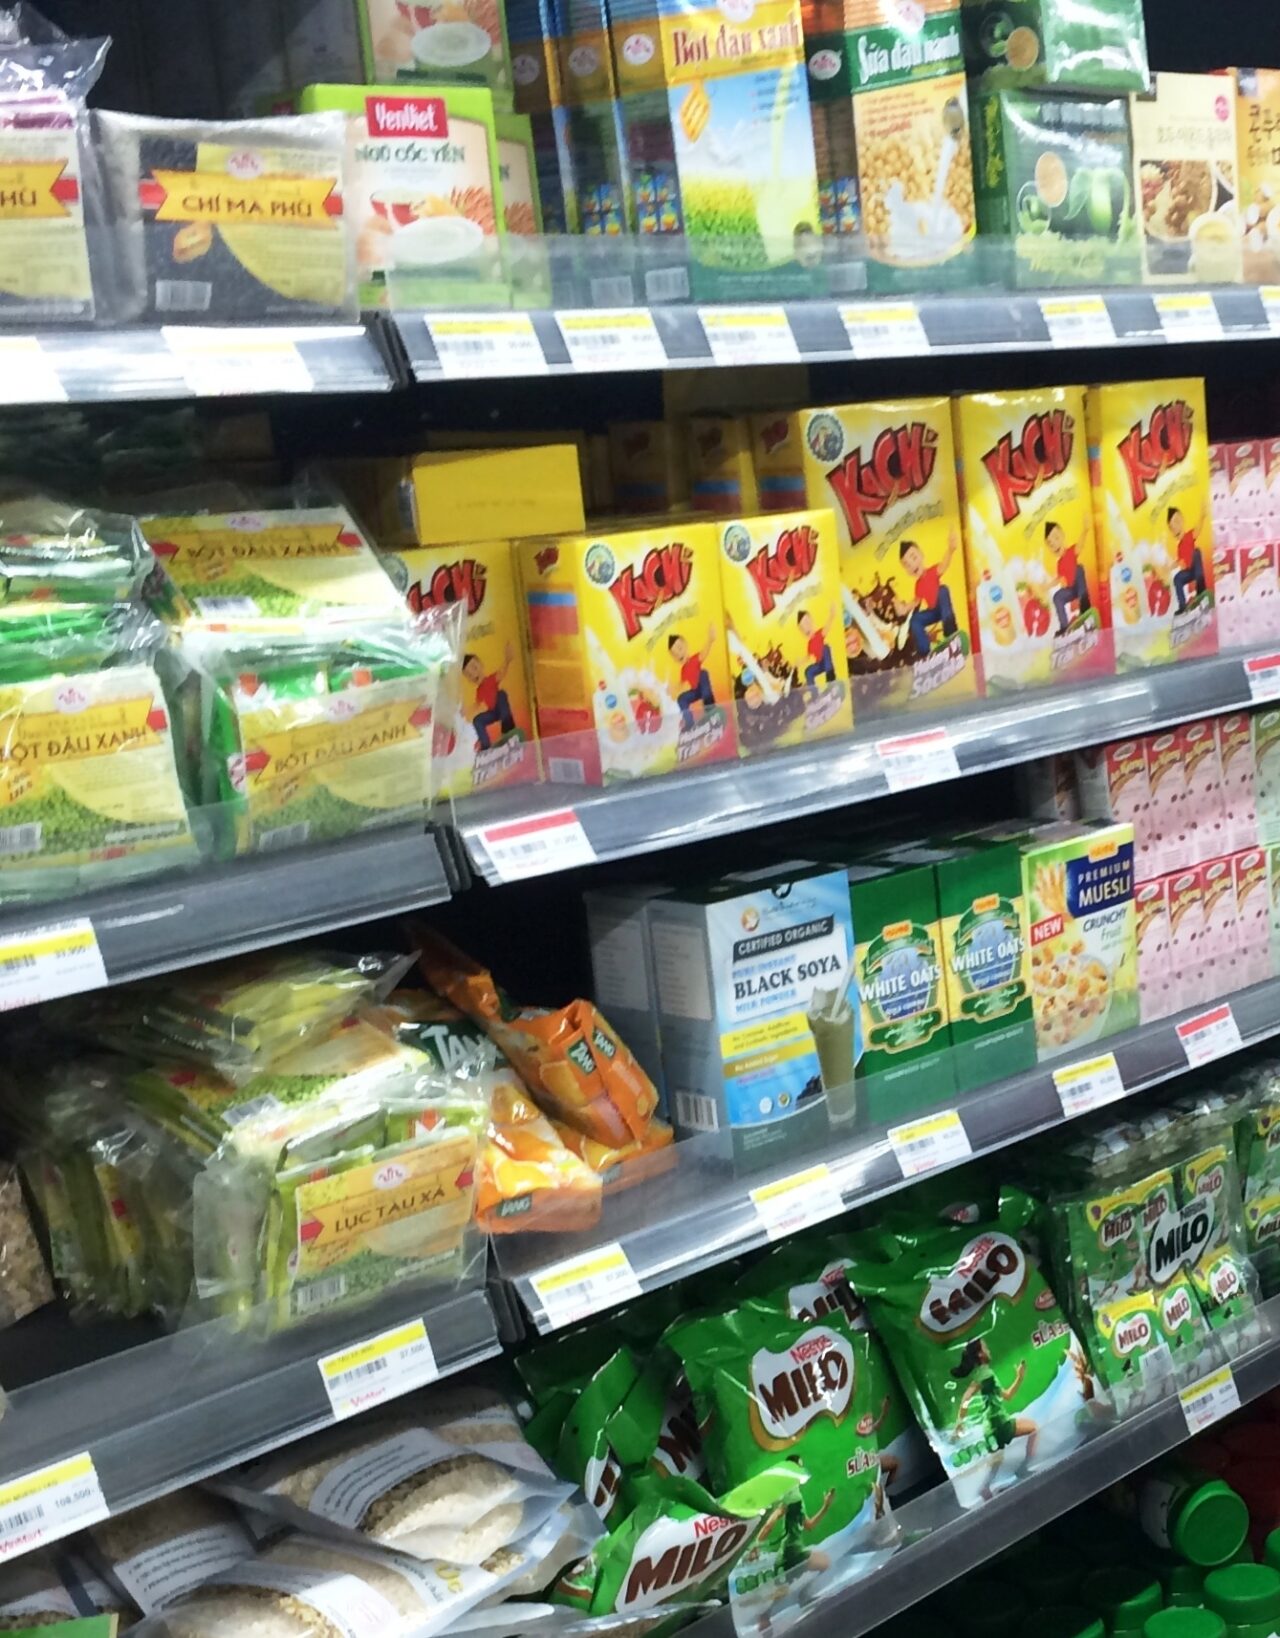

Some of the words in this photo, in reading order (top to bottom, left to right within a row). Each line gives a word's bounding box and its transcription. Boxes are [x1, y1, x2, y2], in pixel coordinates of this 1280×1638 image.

[0, 186, 37, 208] HÙ
[226, 197, 264, 215] MA
[1077, 859, 1131, 886] PREMIUM
[1078, 874, 1132, 910] MUESLI
[738, 932, 783, 956] CERTIFIED
[784, 919, 829, 944] ORGANIC
[1033, 917, 1063, 943] NEW
[1083, 906, 1129, 933] CRUNCHY
[952, 950, 996, 975] WHITE
[997, 938, 1027, 959] OATS
[734, 967, 795, 1001] BLACK
[797, 953, 842, 983] SOYA
[859, 973, 908, 1003] WHITE
[909, 964, 943, 988] OATS
[420, 1024, 499, 1073] TAN
[1154, 1211, 1210, 1273] MILO
[928, 1243, 1019, 1326] MILO
[1214, 1269, 1239, 1297] MILO
[1166, 1297, 1191, 1326] MILO
[1118, 1323, 1149, 1349] MILO
[758, 1350, 849, 1426] MILO
[625, 1523, 748, 1606] MILO
